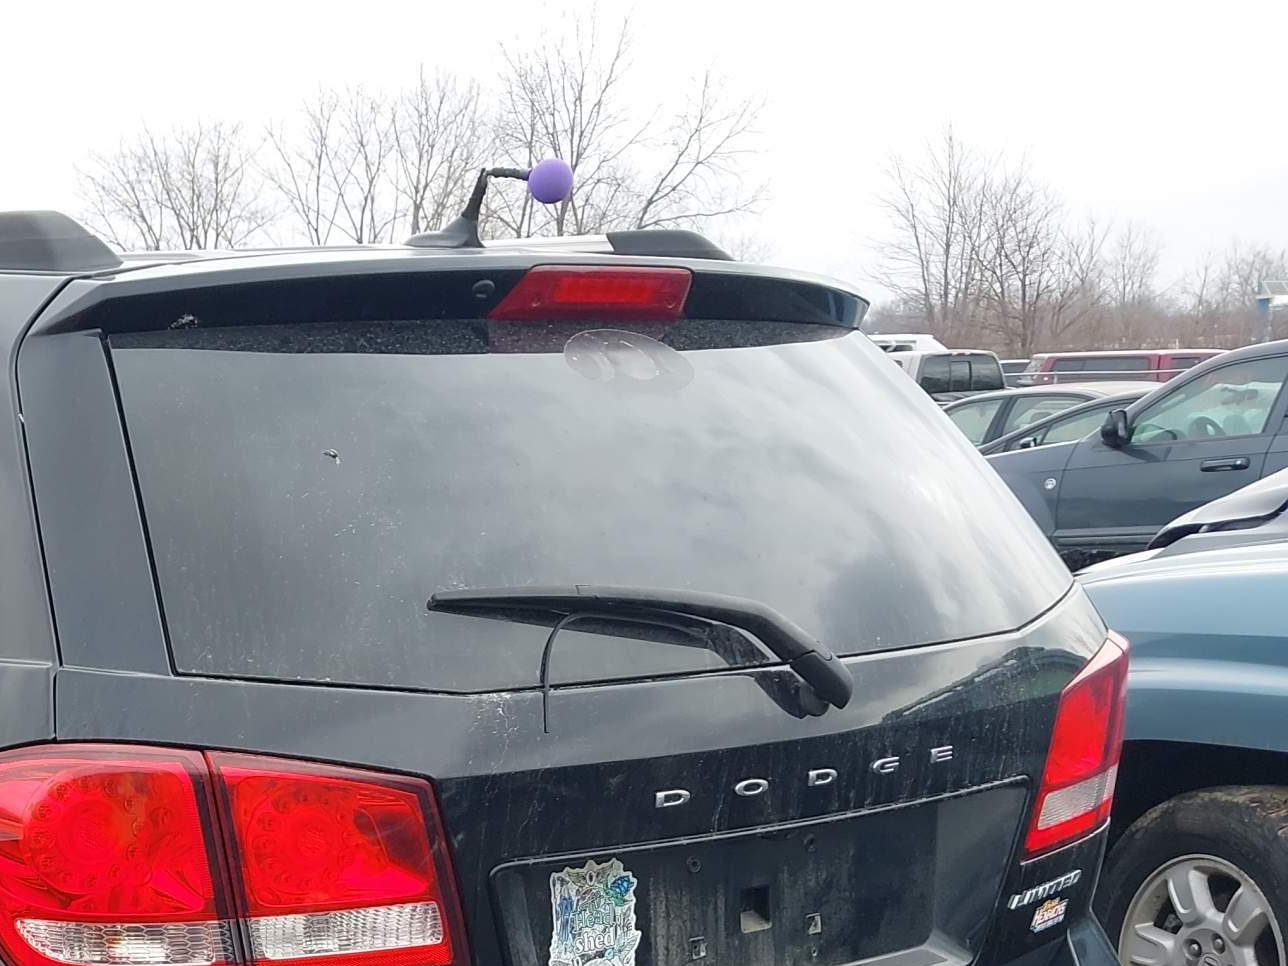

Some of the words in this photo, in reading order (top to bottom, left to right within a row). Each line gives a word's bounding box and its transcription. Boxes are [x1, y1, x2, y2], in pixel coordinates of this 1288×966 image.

[656, 745, 952, 808] DODGE
[1007, 869, 1082, 910] LIMITED
[575, 925, 616, 953] shed
